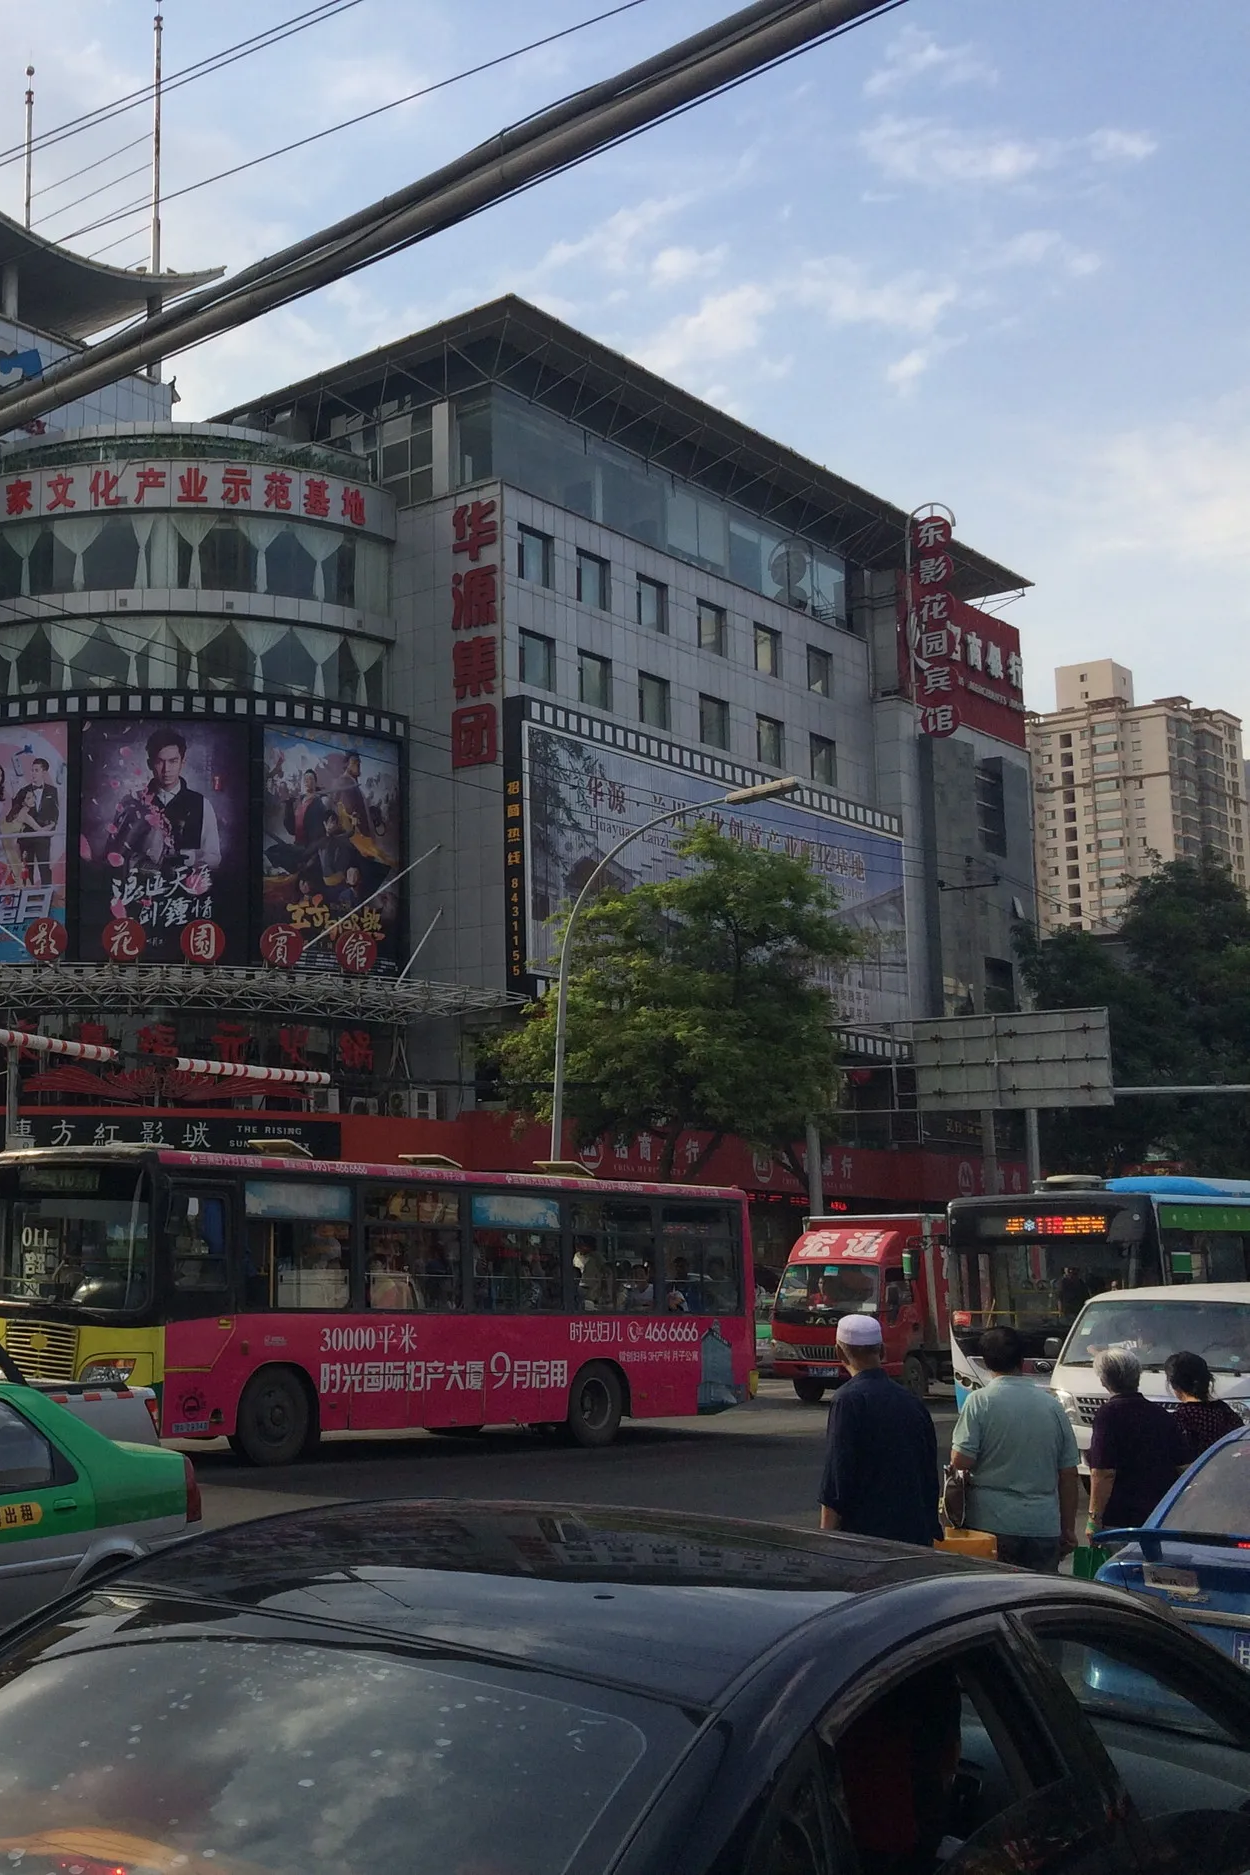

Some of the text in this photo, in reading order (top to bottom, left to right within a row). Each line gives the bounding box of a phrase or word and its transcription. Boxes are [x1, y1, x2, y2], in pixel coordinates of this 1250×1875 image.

[452, 500, 497, 769] 华源集团
[917, 521, 953, 732] 东影花园宾馆
[510, 878, 520, 976] 8431155
[236, 1125, 302, 1136] THE RISING
[798, 1231, 884, 1257] 宏远
[569, 1320, 623, 1343] 时光妇儿
[805, 1316, 838, 1325] JAC
[320, 1323, 418, 1353] 30000平米
